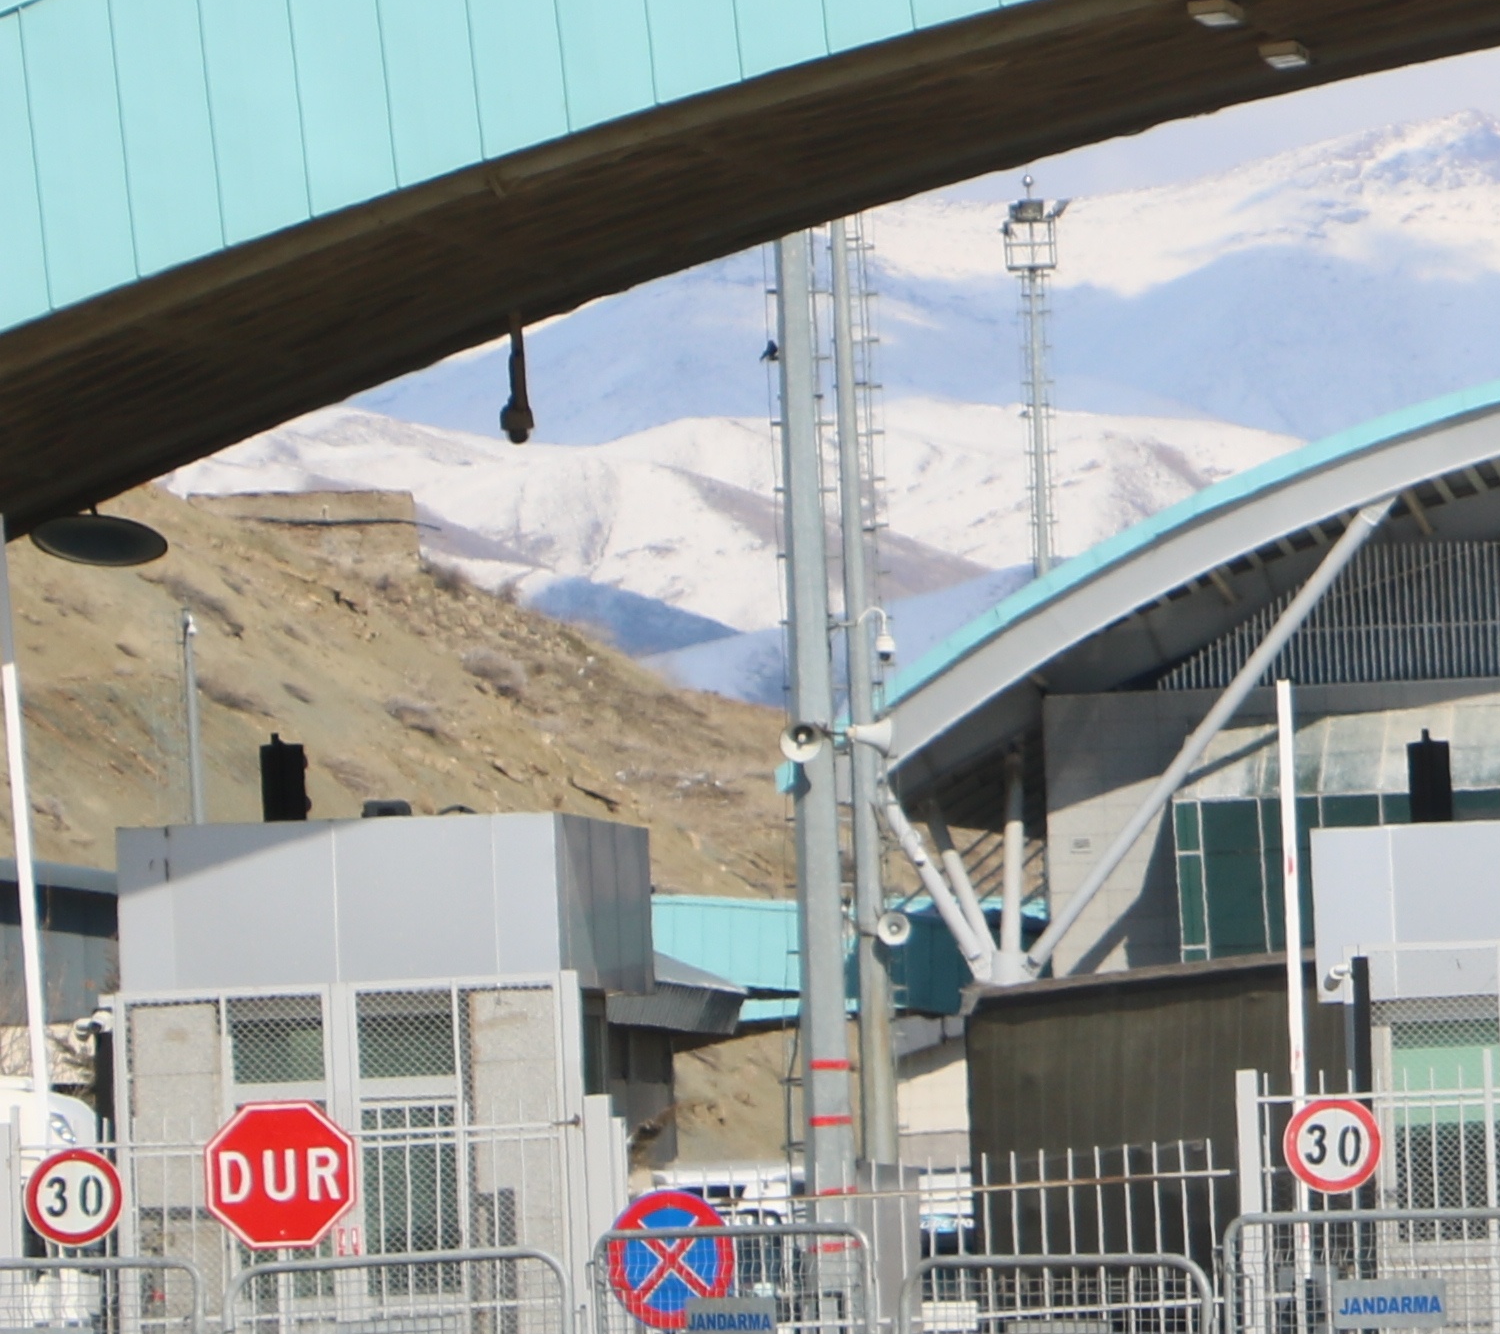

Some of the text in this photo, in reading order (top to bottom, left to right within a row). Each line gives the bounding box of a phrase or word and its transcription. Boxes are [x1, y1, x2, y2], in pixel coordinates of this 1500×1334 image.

[1304, 1123, 1362, 1167] 30
[45, 1174, 104, 1218] 30
[218, 1146, 342, 1205] DUR
[688, 1312, 773, 1332] JANDARMA
[1339, 1295, 1443, 1315] JANDARMA
